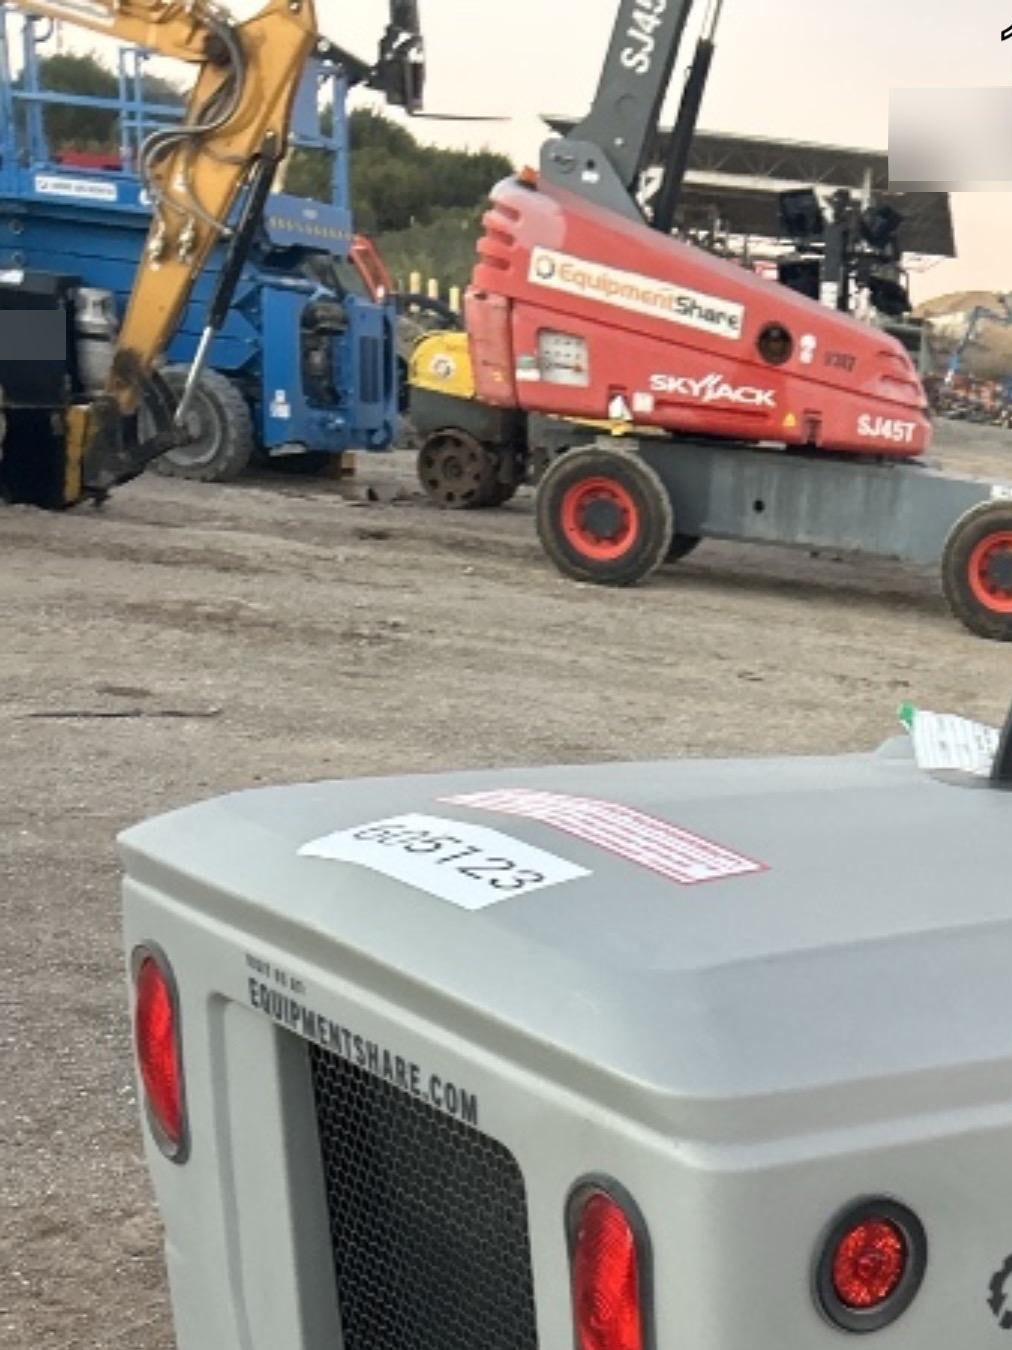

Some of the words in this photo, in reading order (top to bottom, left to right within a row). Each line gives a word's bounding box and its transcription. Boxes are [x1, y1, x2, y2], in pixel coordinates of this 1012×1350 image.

[649, 373, 776, 408] SKYJACK
[857, 413, 916, 443] SJ45T
[353, 823, 546, 890] 605123
[248, 976, 478, 1126] EQUIPMENTSHARE.COM
